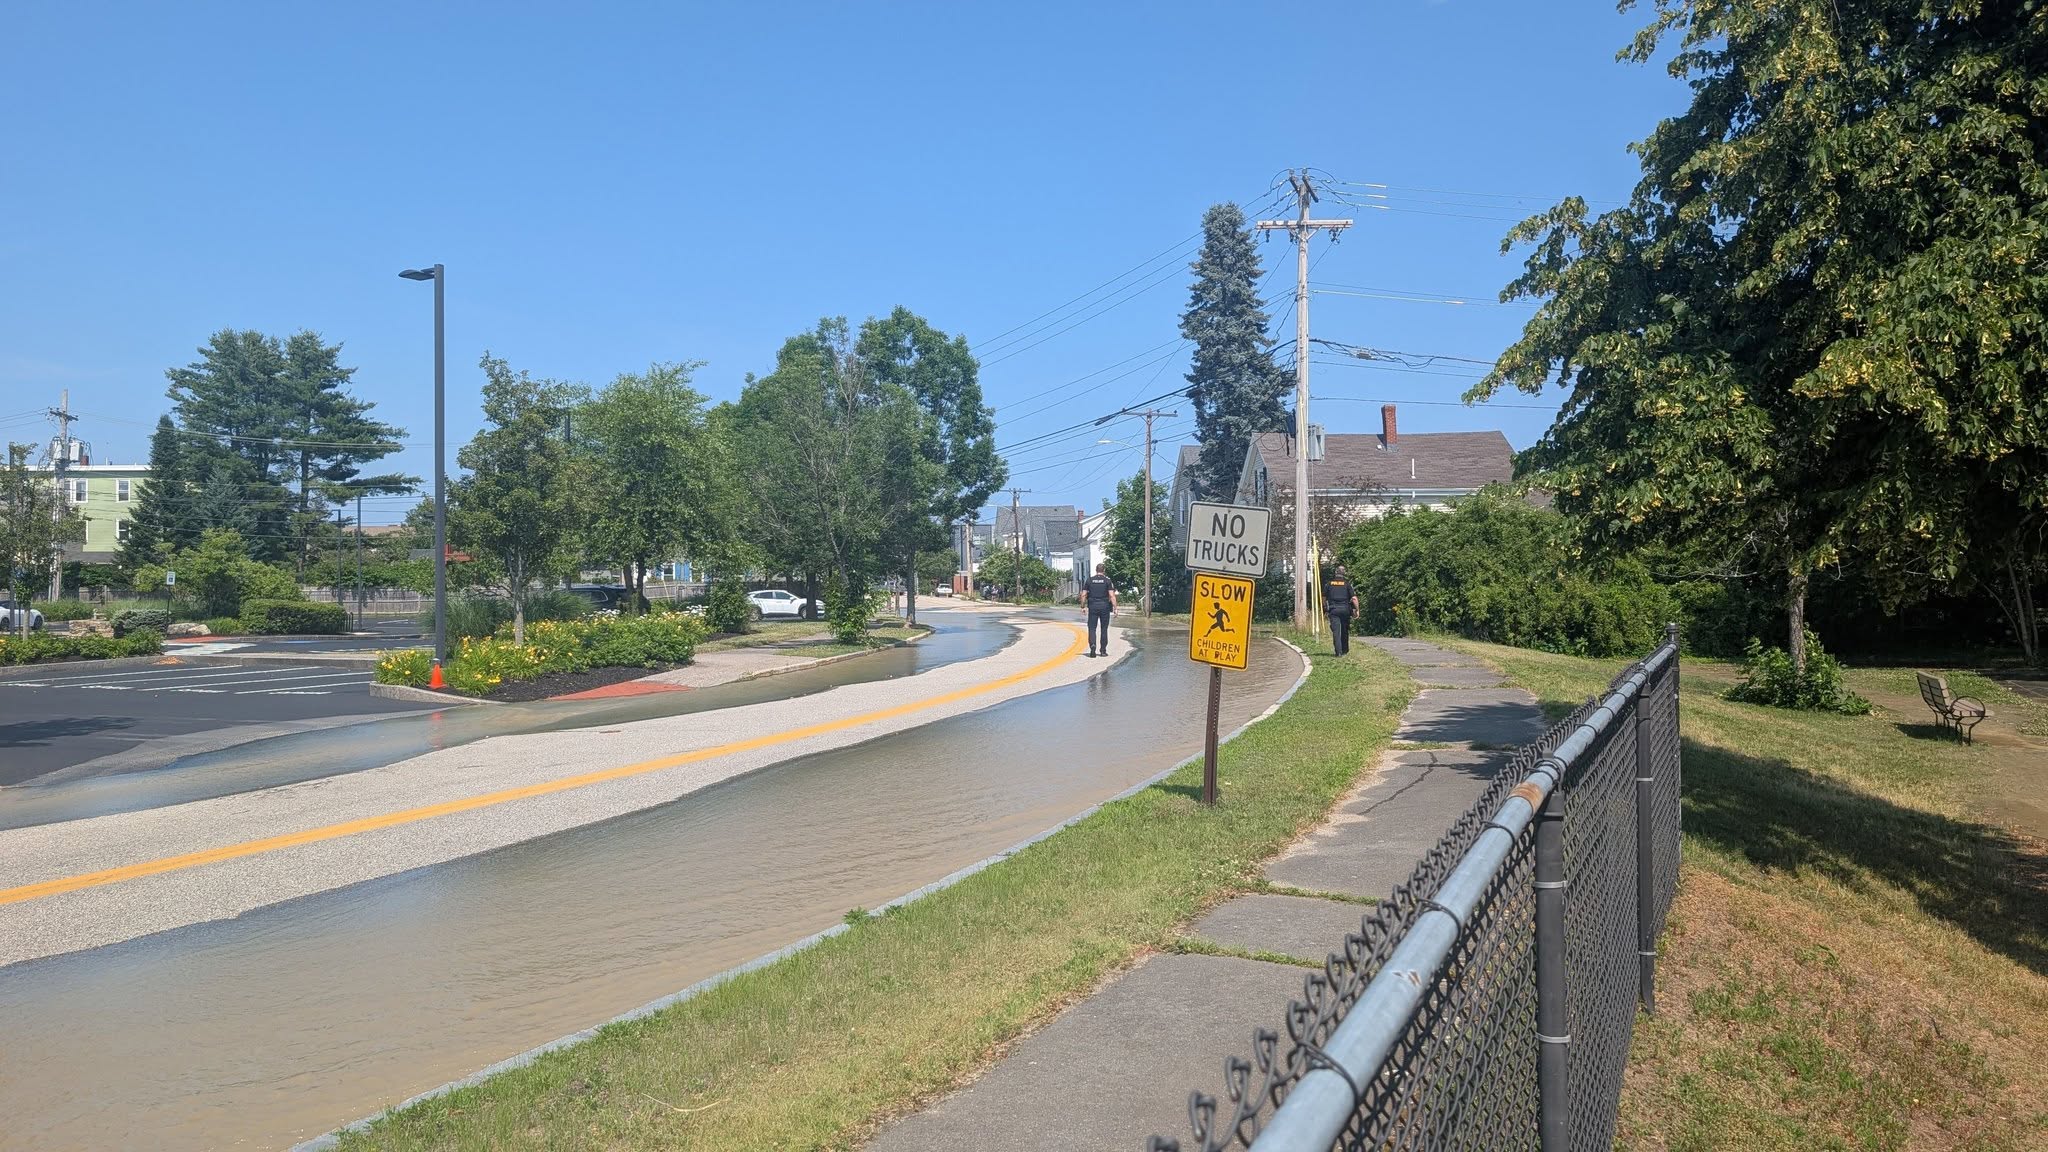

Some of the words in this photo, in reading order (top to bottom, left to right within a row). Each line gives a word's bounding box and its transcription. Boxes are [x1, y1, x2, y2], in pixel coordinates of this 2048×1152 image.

[1212, 513, 1246, 539] NO
[1193, 539, 1259, 567] TRUCKS
[1200, 581, 1246, 603] SLOW
[1197, 639, 1240, 654] CHILDREN
[1198, 648, 1208, 657] AT
[1214, 651, 1237, 662] PLAY
